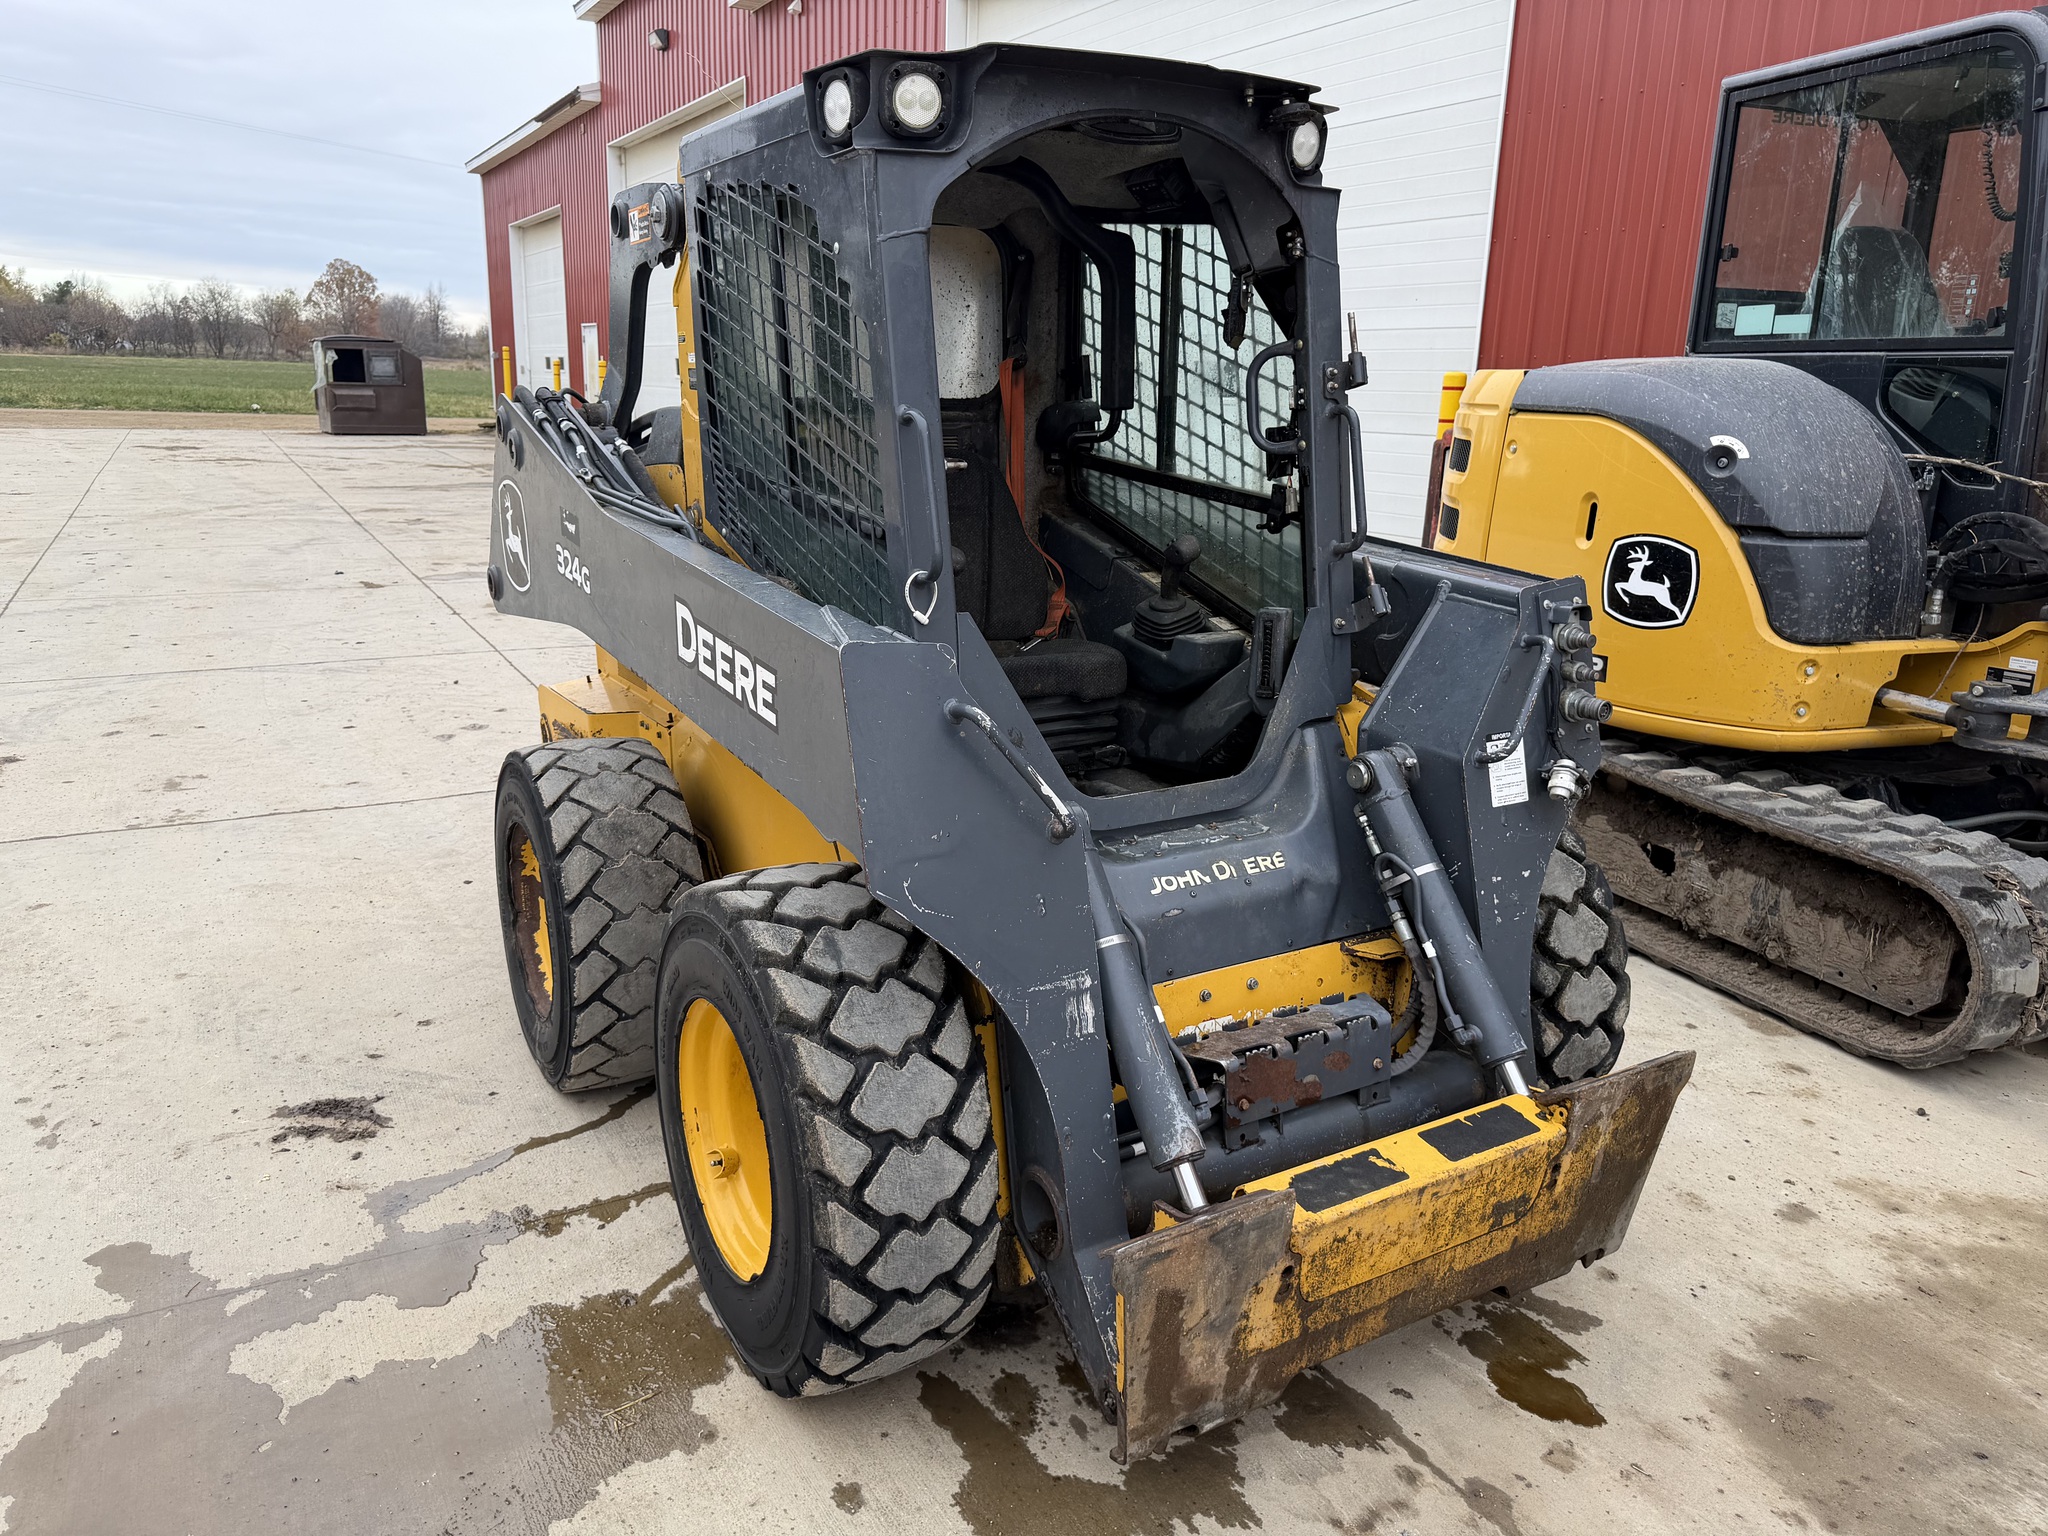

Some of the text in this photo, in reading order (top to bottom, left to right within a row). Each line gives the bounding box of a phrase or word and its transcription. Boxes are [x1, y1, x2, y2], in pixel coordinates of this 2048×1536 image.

[555, 543, 591, 594] 324G
[674, 600, 777, 727] DEERE
[1211, 851, 1286, 881] DERE
